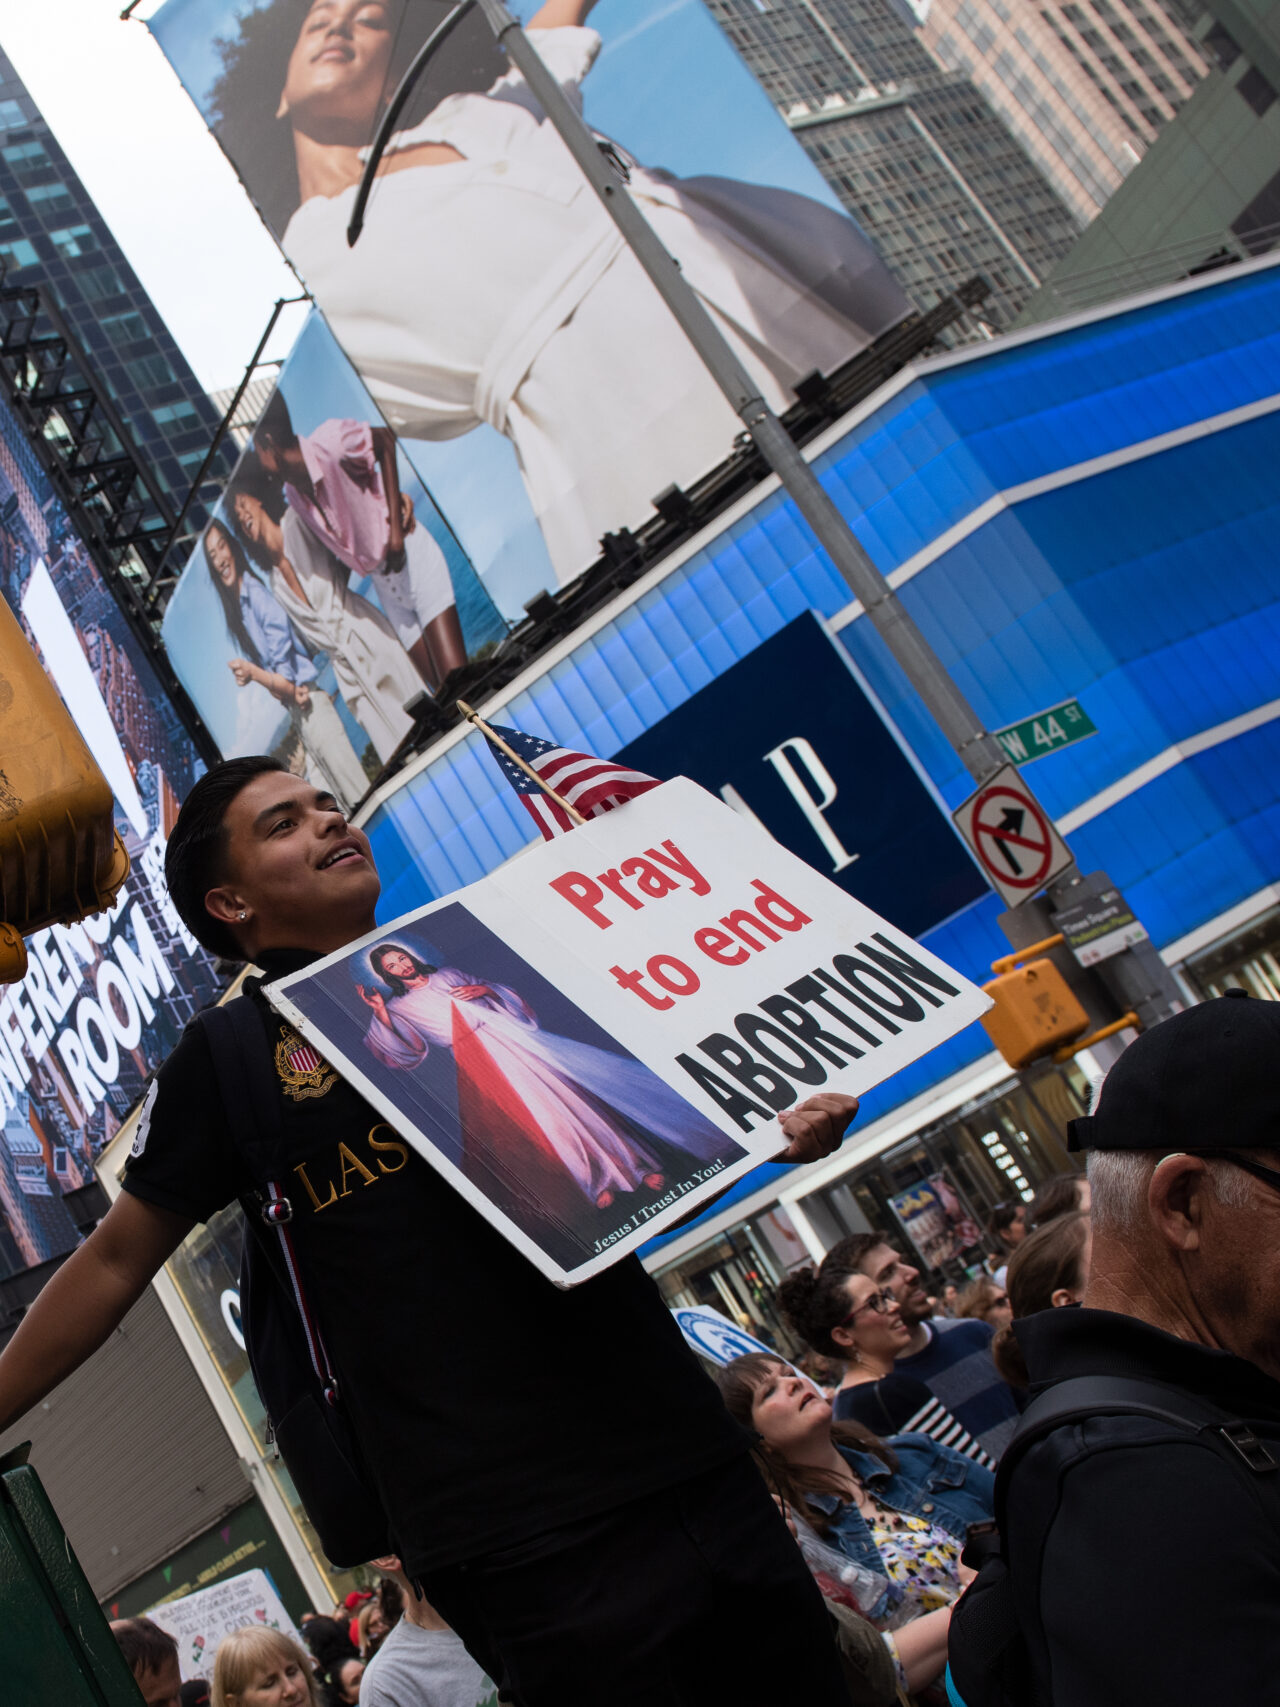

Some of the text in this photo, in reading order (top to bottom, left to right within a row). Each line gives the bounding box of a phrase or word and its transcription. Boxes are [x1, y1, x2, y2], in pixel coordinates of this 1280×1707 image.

[1000, 730, 1028, 761] W
[1032, 715, 1069, 748] 44
[548, 839, 712, 930] Pray
[608, 878, 814, 1011] to end
[57, 901, 175, 1117] ROOM
[674, 932, 962, 1134] ABORTION
[293, 1123, 409, 1213] LAS
[593, 1158, 726, 1253] Jesus I Trust In You!
